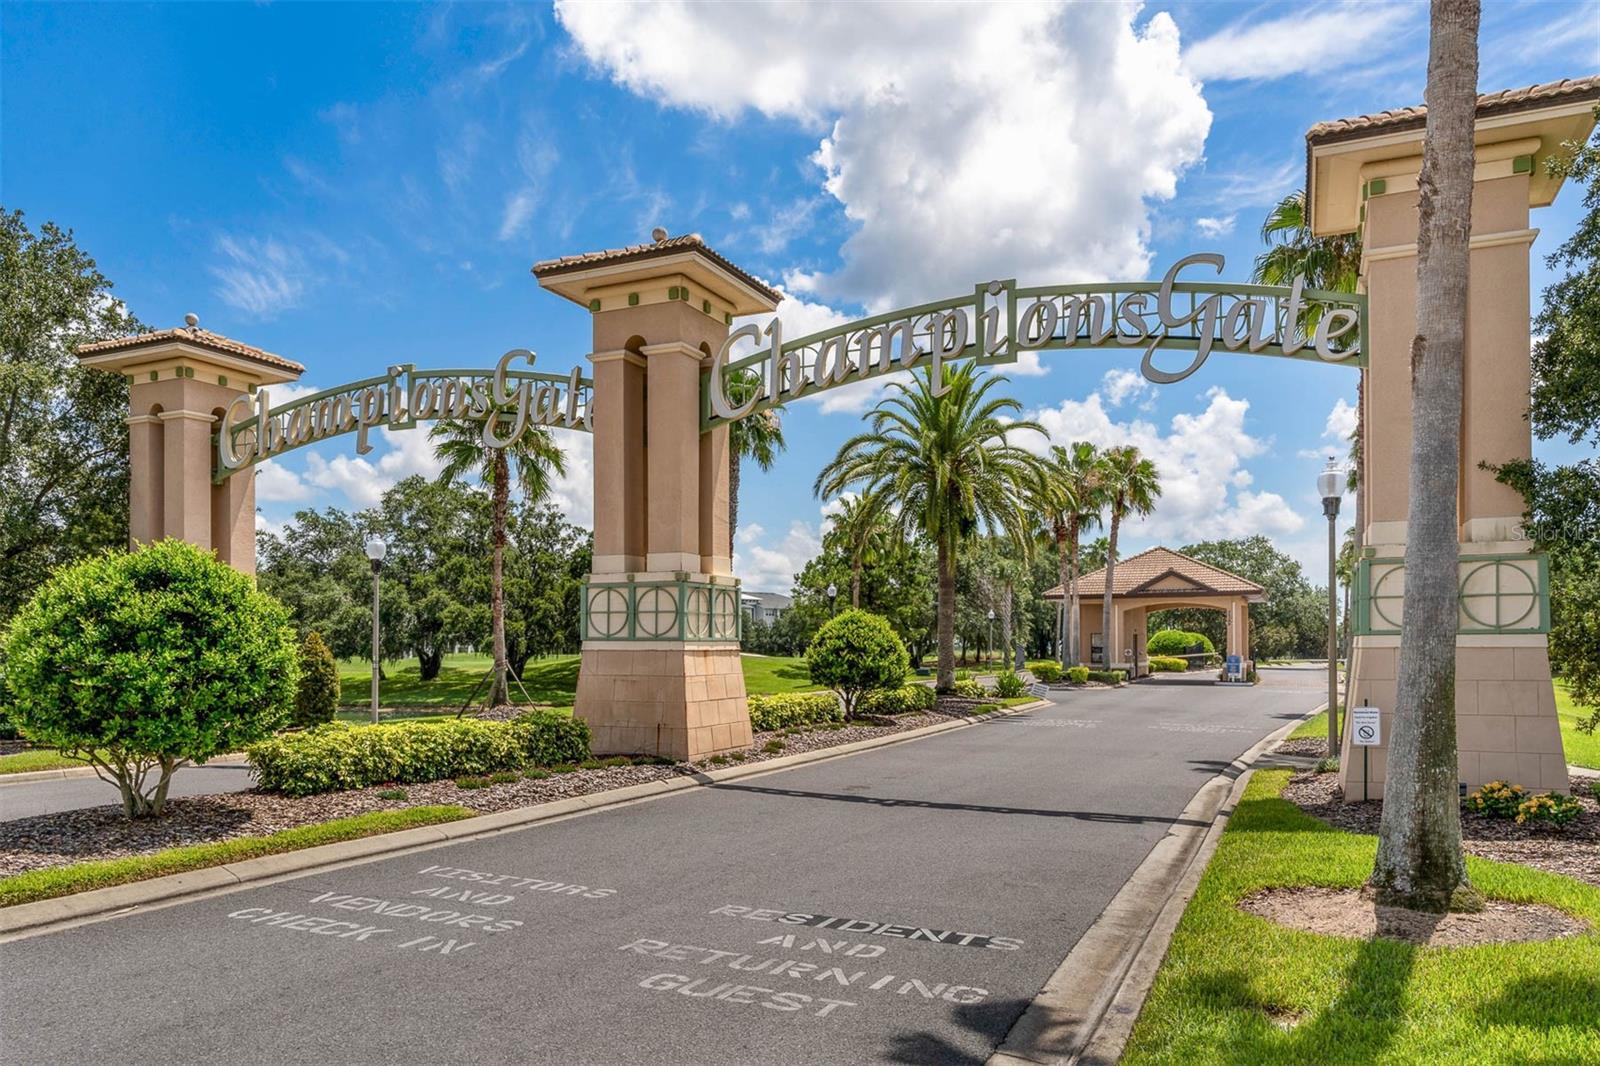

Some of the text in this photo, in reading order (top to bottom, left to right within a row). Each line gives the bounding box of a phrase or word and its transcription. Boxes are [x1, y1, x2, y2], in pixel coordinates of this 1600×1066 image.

[710, 253, 1360, 420] ChampionsGate
[410, 886, 515, 906] AND
[417, 865, 618, 899] VISITORS
[227, 907, 477, 954] CHECK IN
[308, 891, 524, 932] VENDORS
[708, 904, 1026, 951] RESIDENTS
[756, 934, 887, 958] AND
[617, 938, 990, 1004] RETURNING
[637, 972, 858, 1017] GUEST
